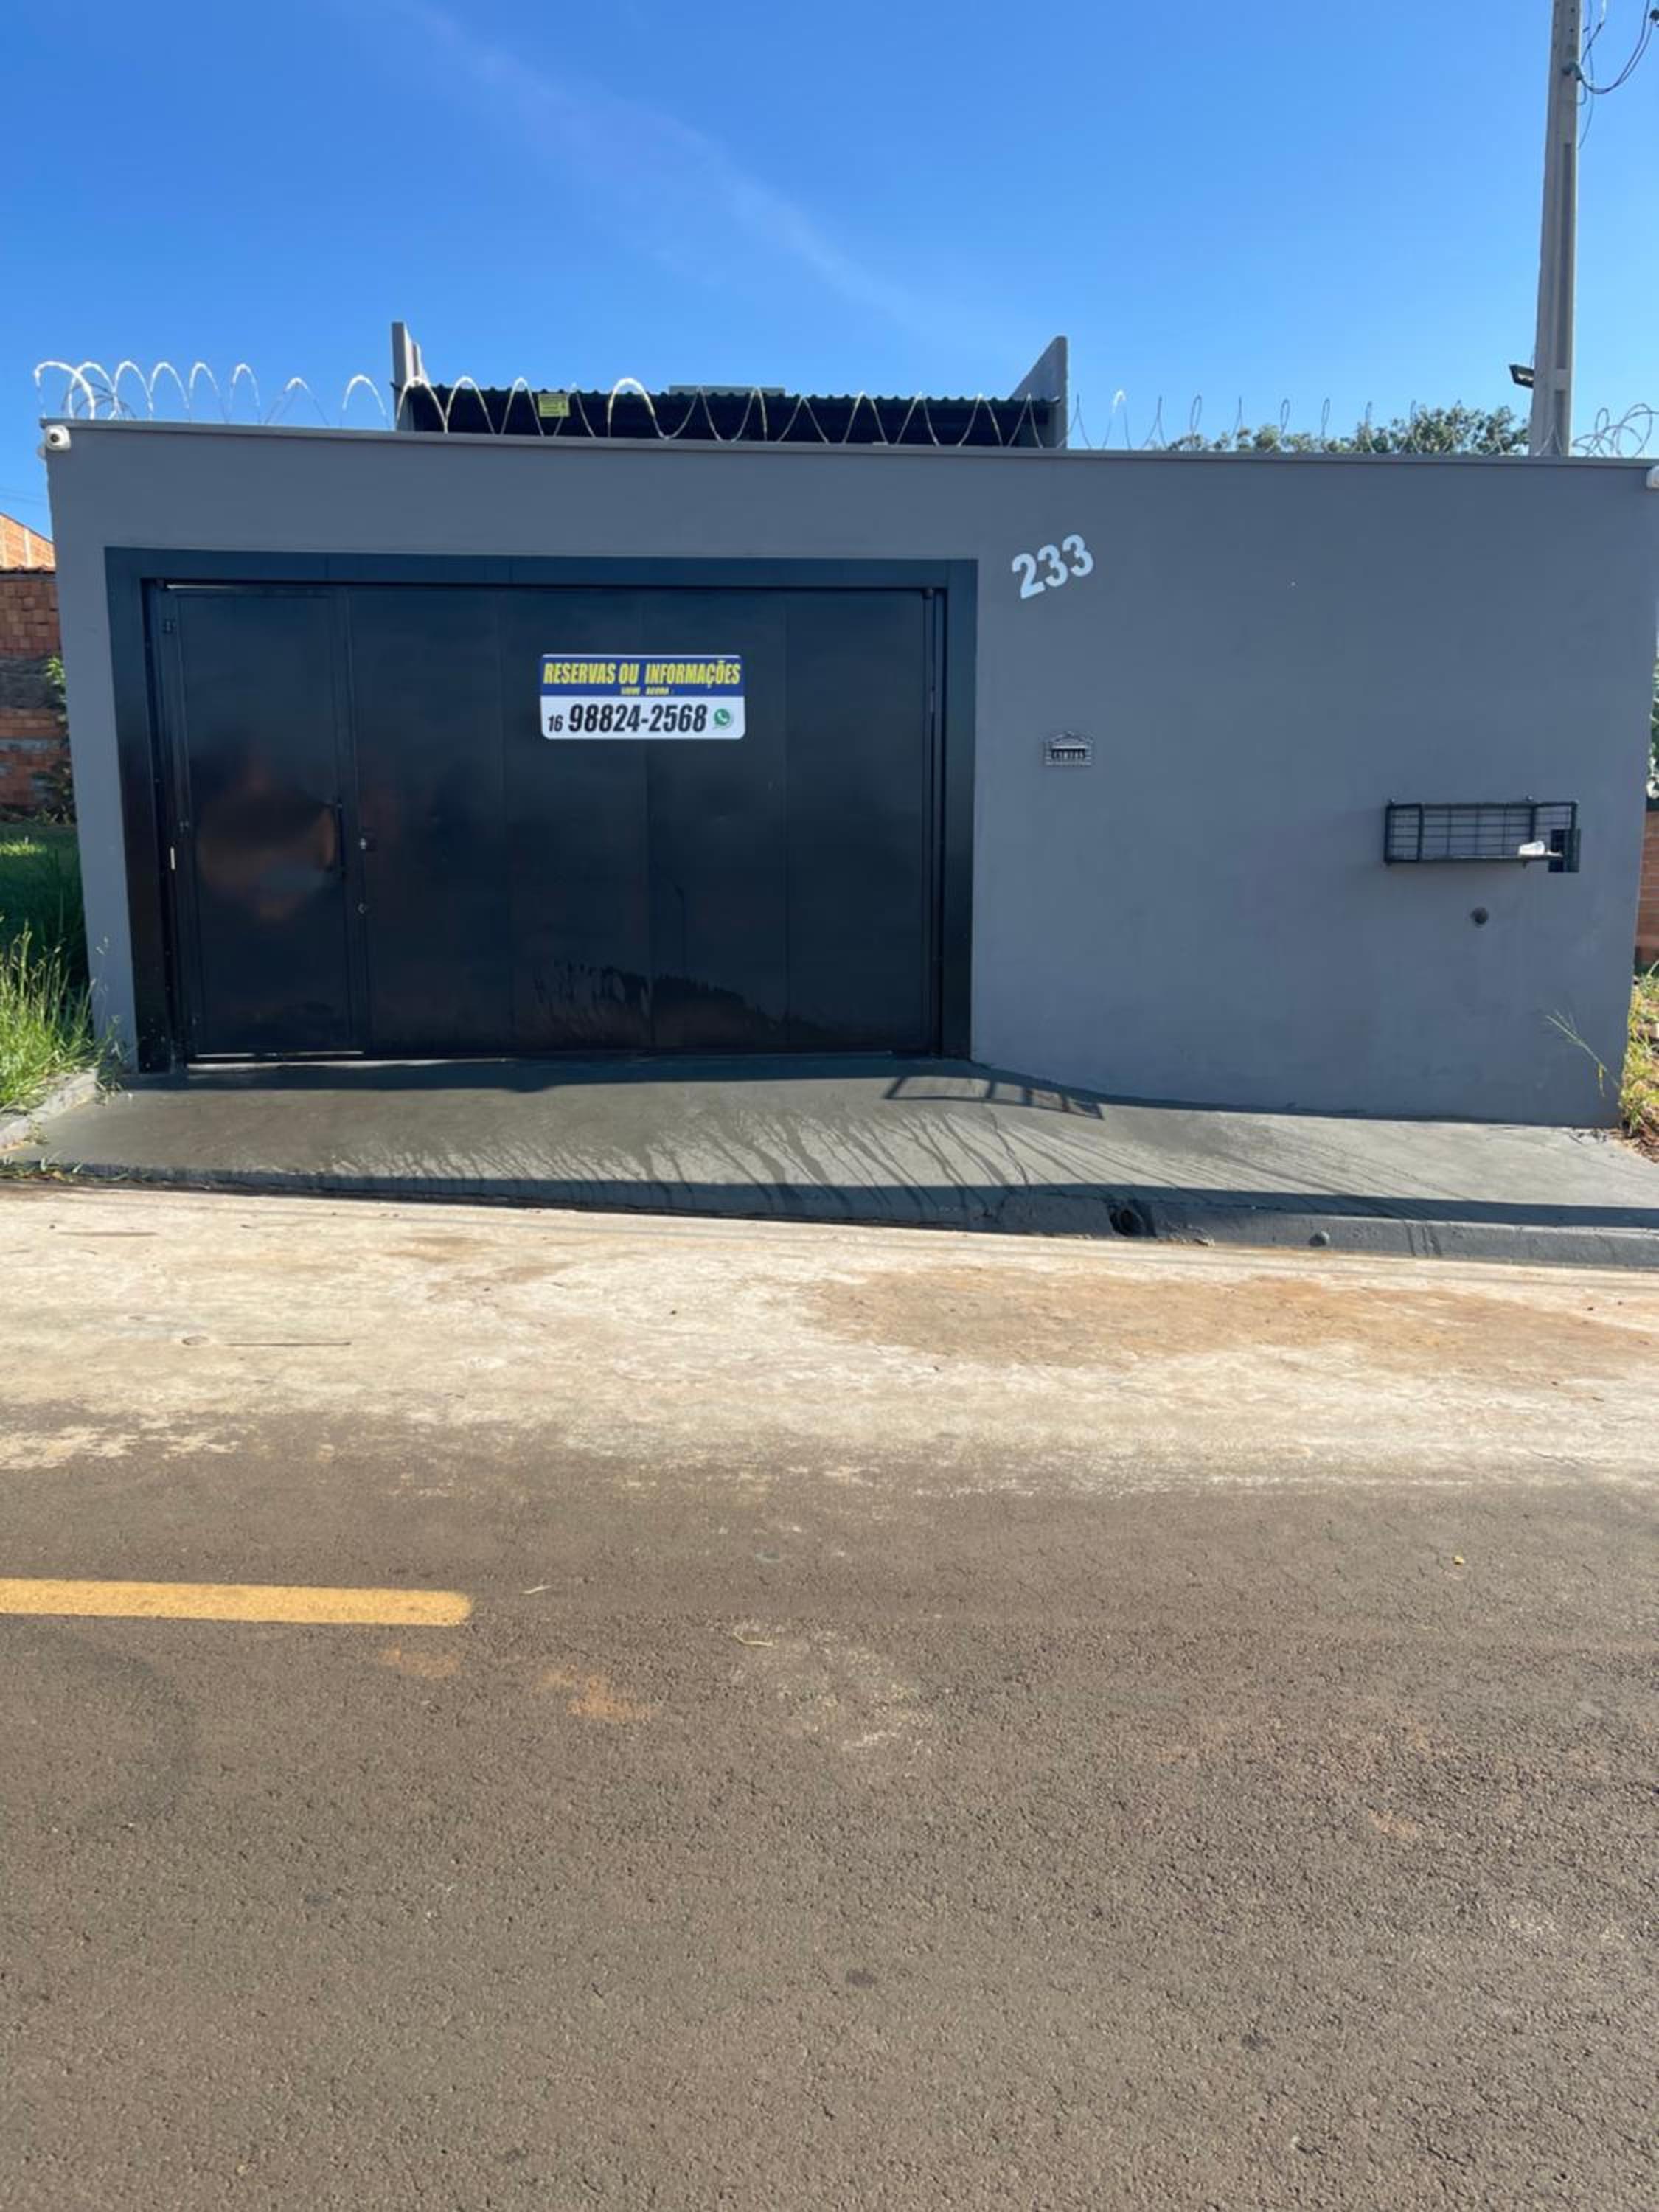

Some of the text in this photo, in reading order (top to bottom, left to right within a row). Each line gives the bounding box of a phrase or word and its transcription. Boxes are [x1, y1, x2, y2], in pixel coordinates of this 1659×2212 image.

[1012, 534, 1093, 599] 233
[543, 660, 741, 689] RESERVAS OU INFORMAÇÕES
[547, 704, 708, 732] 16 98824-2568
